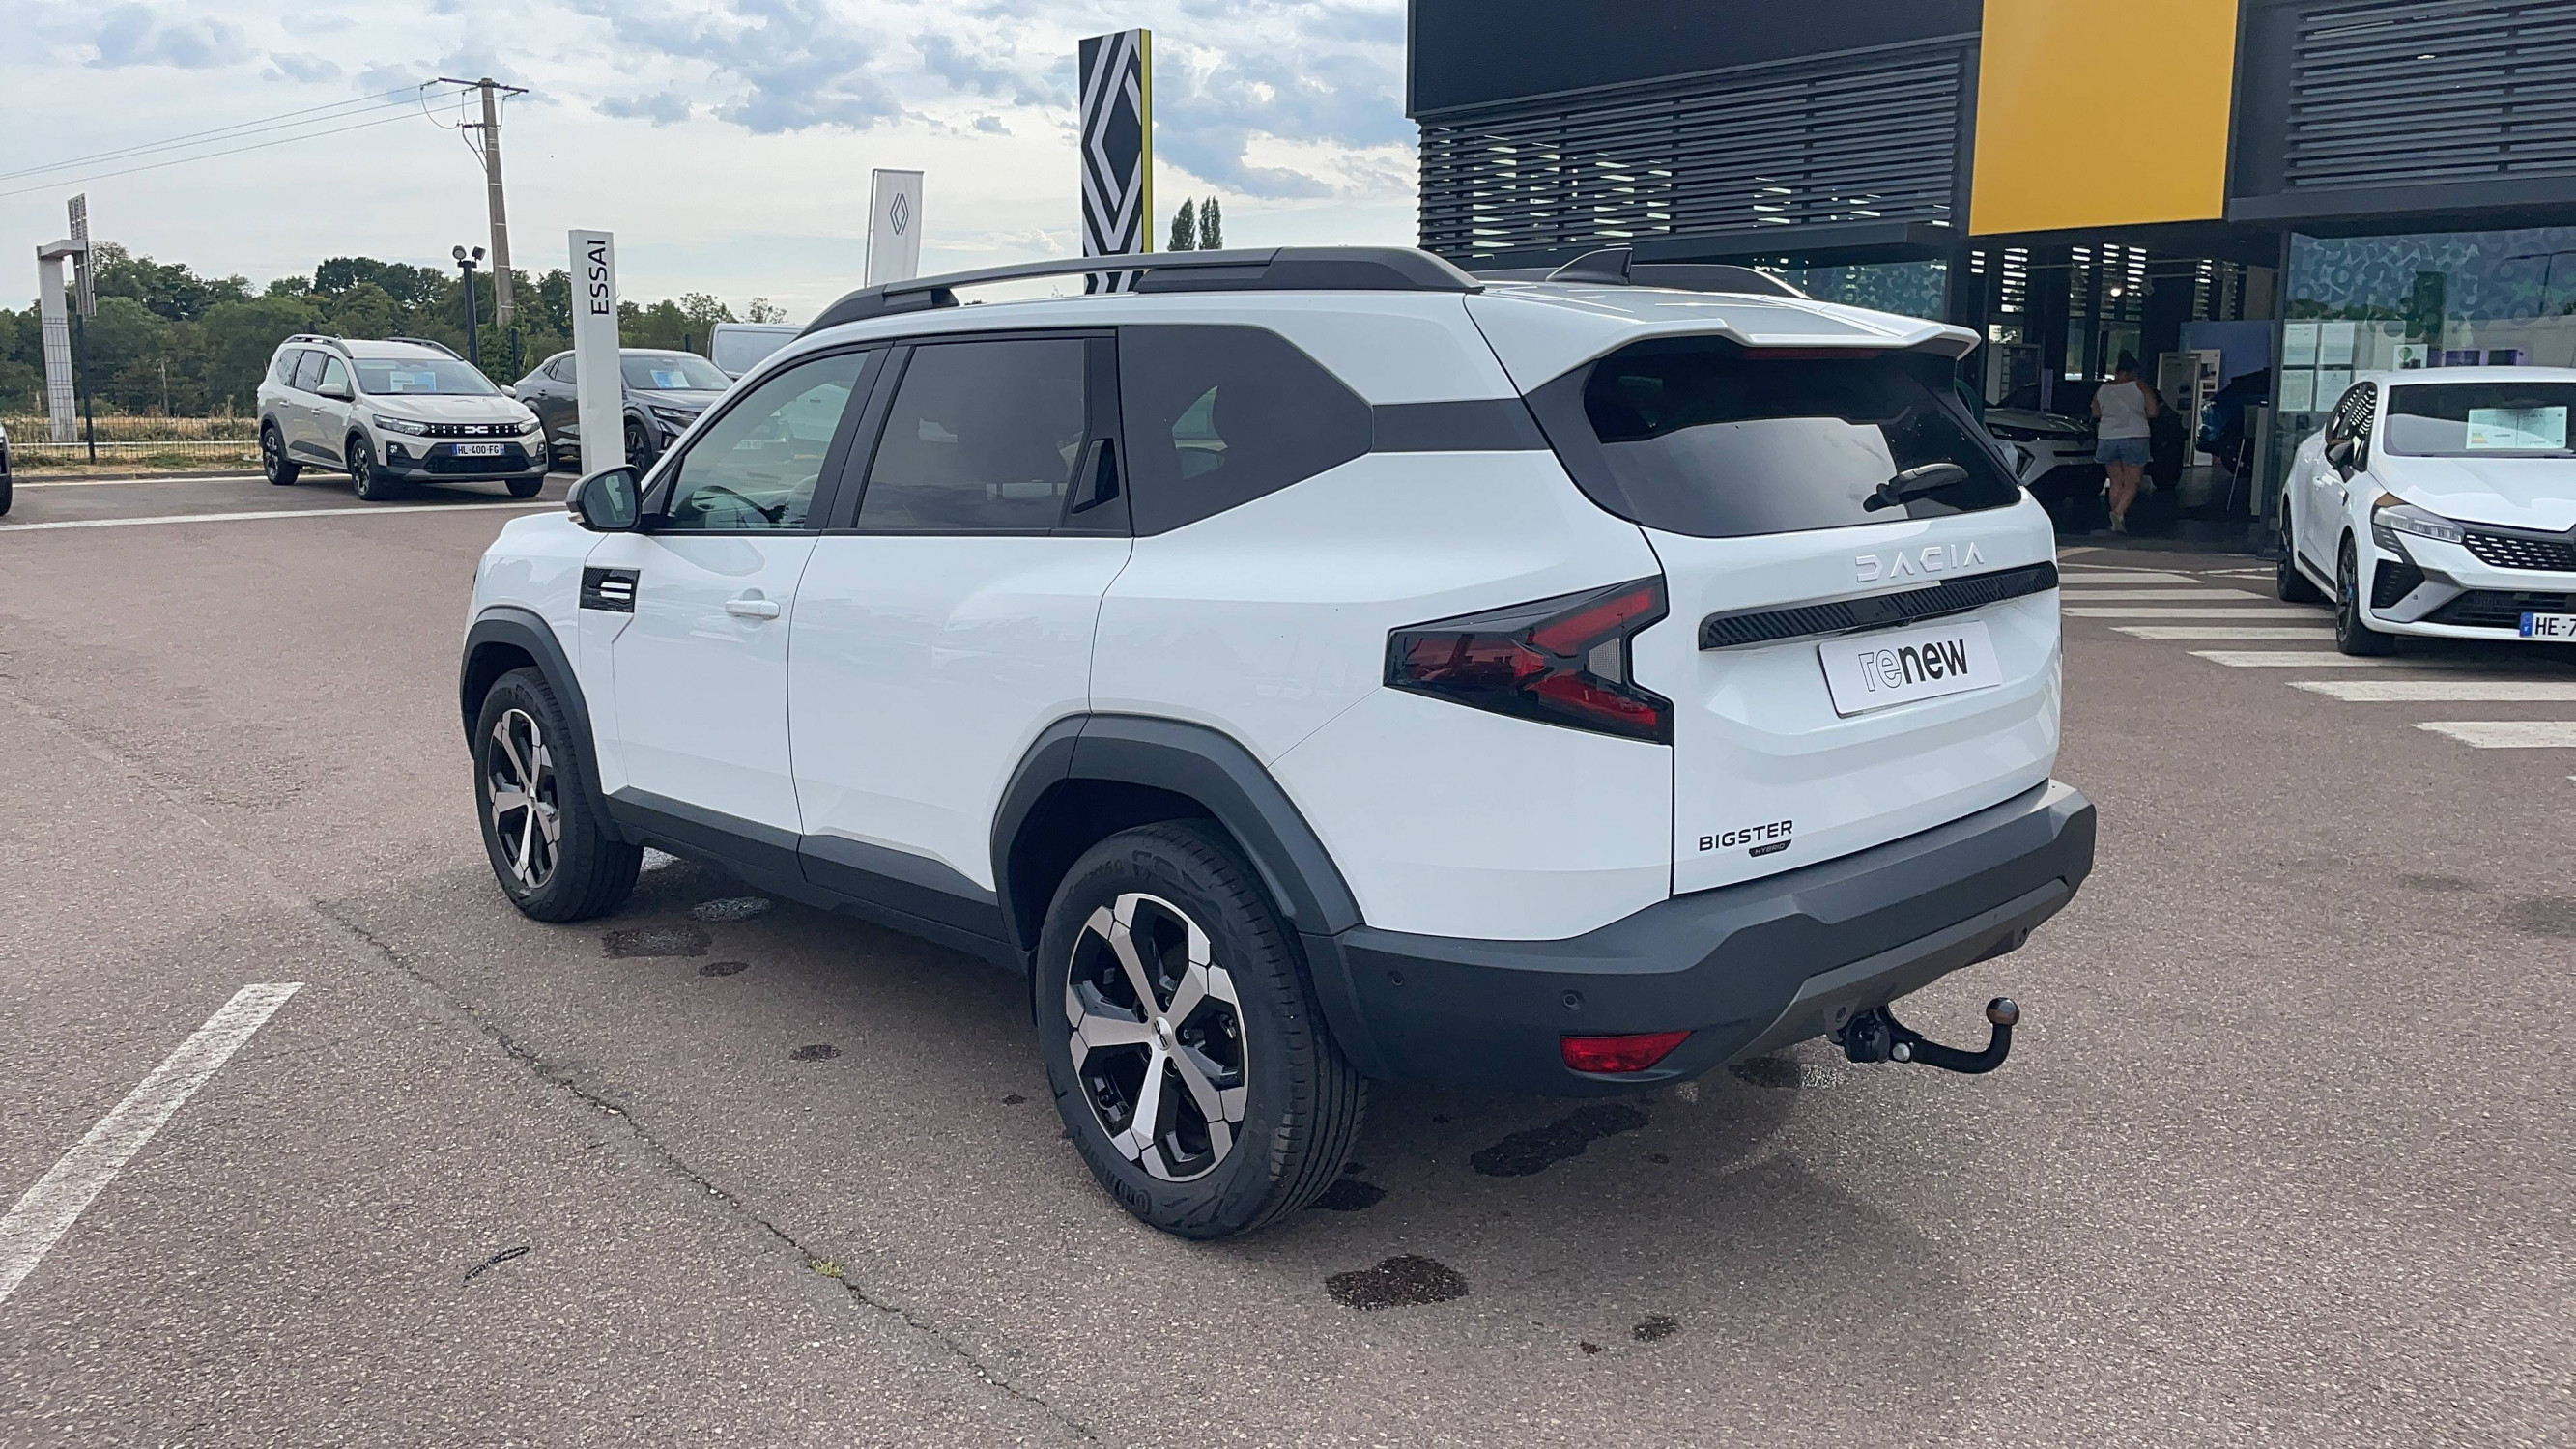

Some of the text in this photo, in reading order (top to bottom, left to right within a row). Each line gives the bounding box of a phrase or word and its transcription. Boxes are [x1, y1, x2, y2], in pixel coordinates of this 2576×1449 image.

[587, 240, 609, 315] ESSAI
[457, 445, 500, 454] HL-400-FG
[1855, 541, 1985, 583] DACIA
[1857, 639, 1968, 692] renew
[1699, 820, 1793, 851] BIGSTER
[1754, 842, 1786, 855] HYBRID
